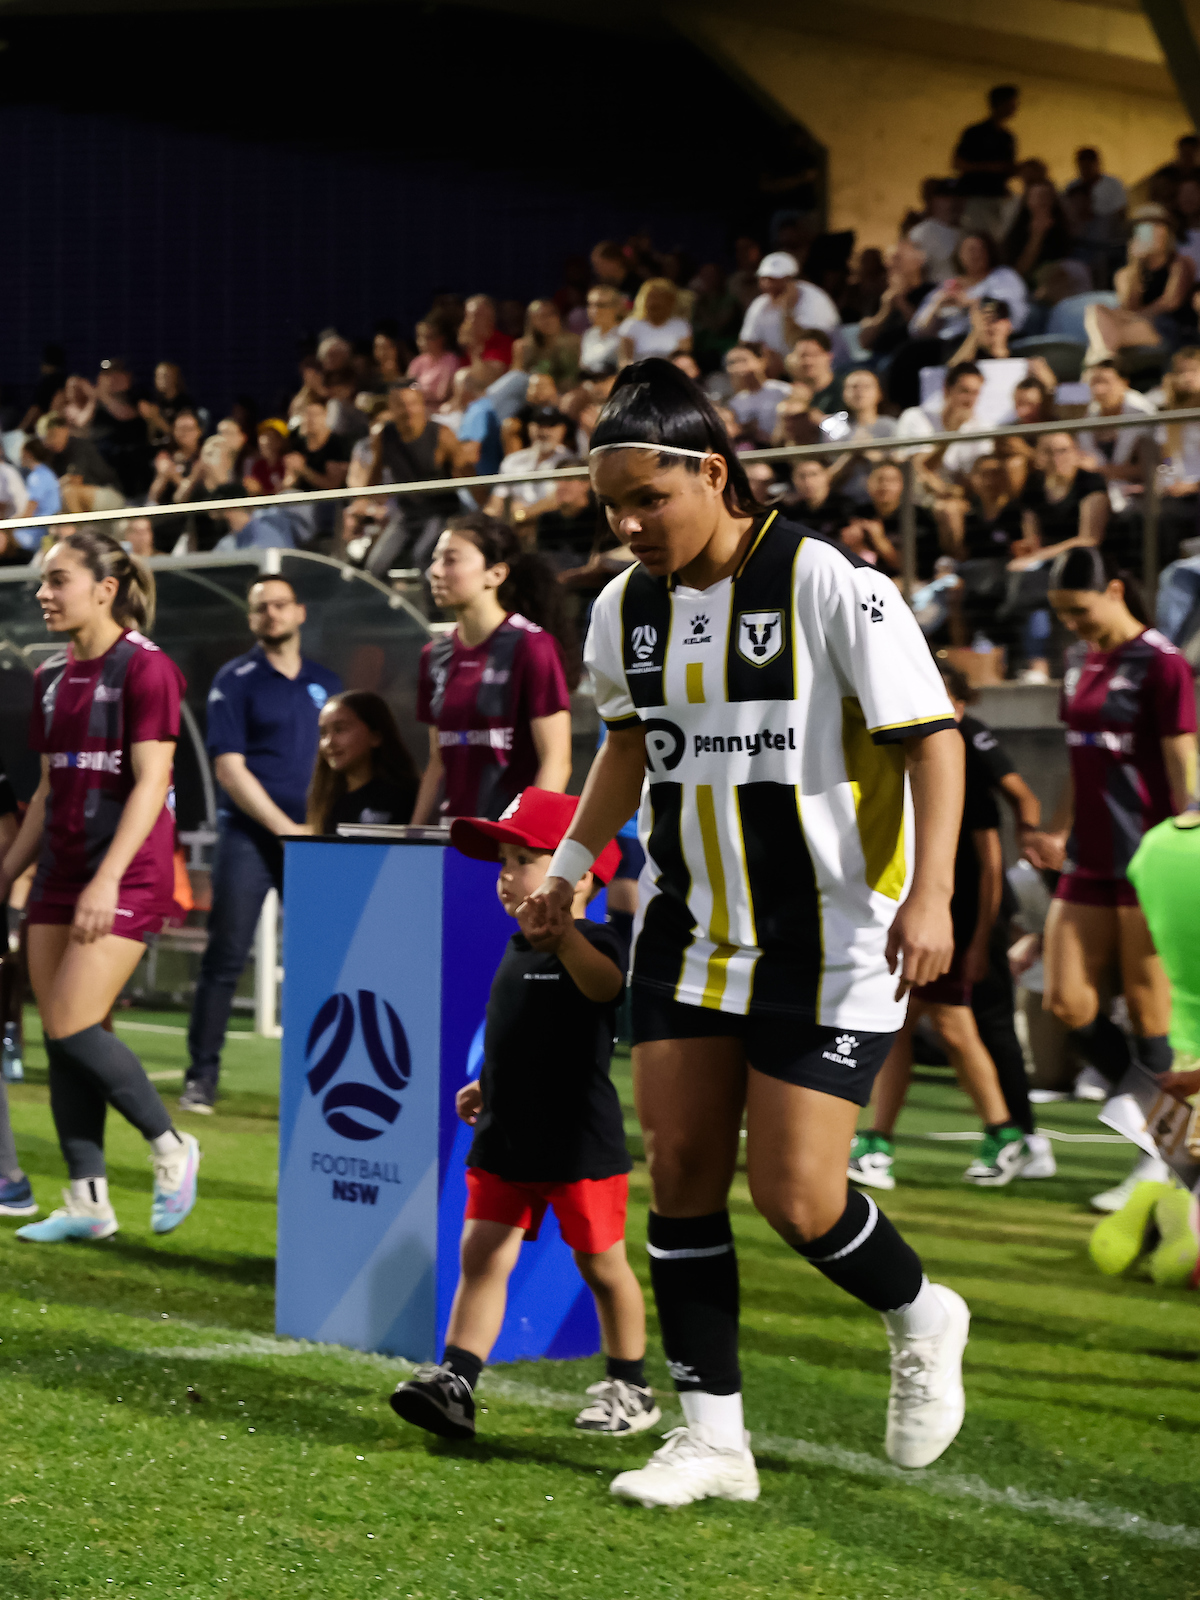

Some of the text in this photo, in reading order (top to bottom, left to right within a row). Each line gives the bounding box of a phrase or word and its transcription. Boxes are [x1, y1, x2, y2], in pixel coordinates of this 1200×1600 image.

[694, 727, 796, 758] pennytel
[311, 1152, 402, 1184] FOOTBALL
[332, 1179, 380, 1206] NSW
